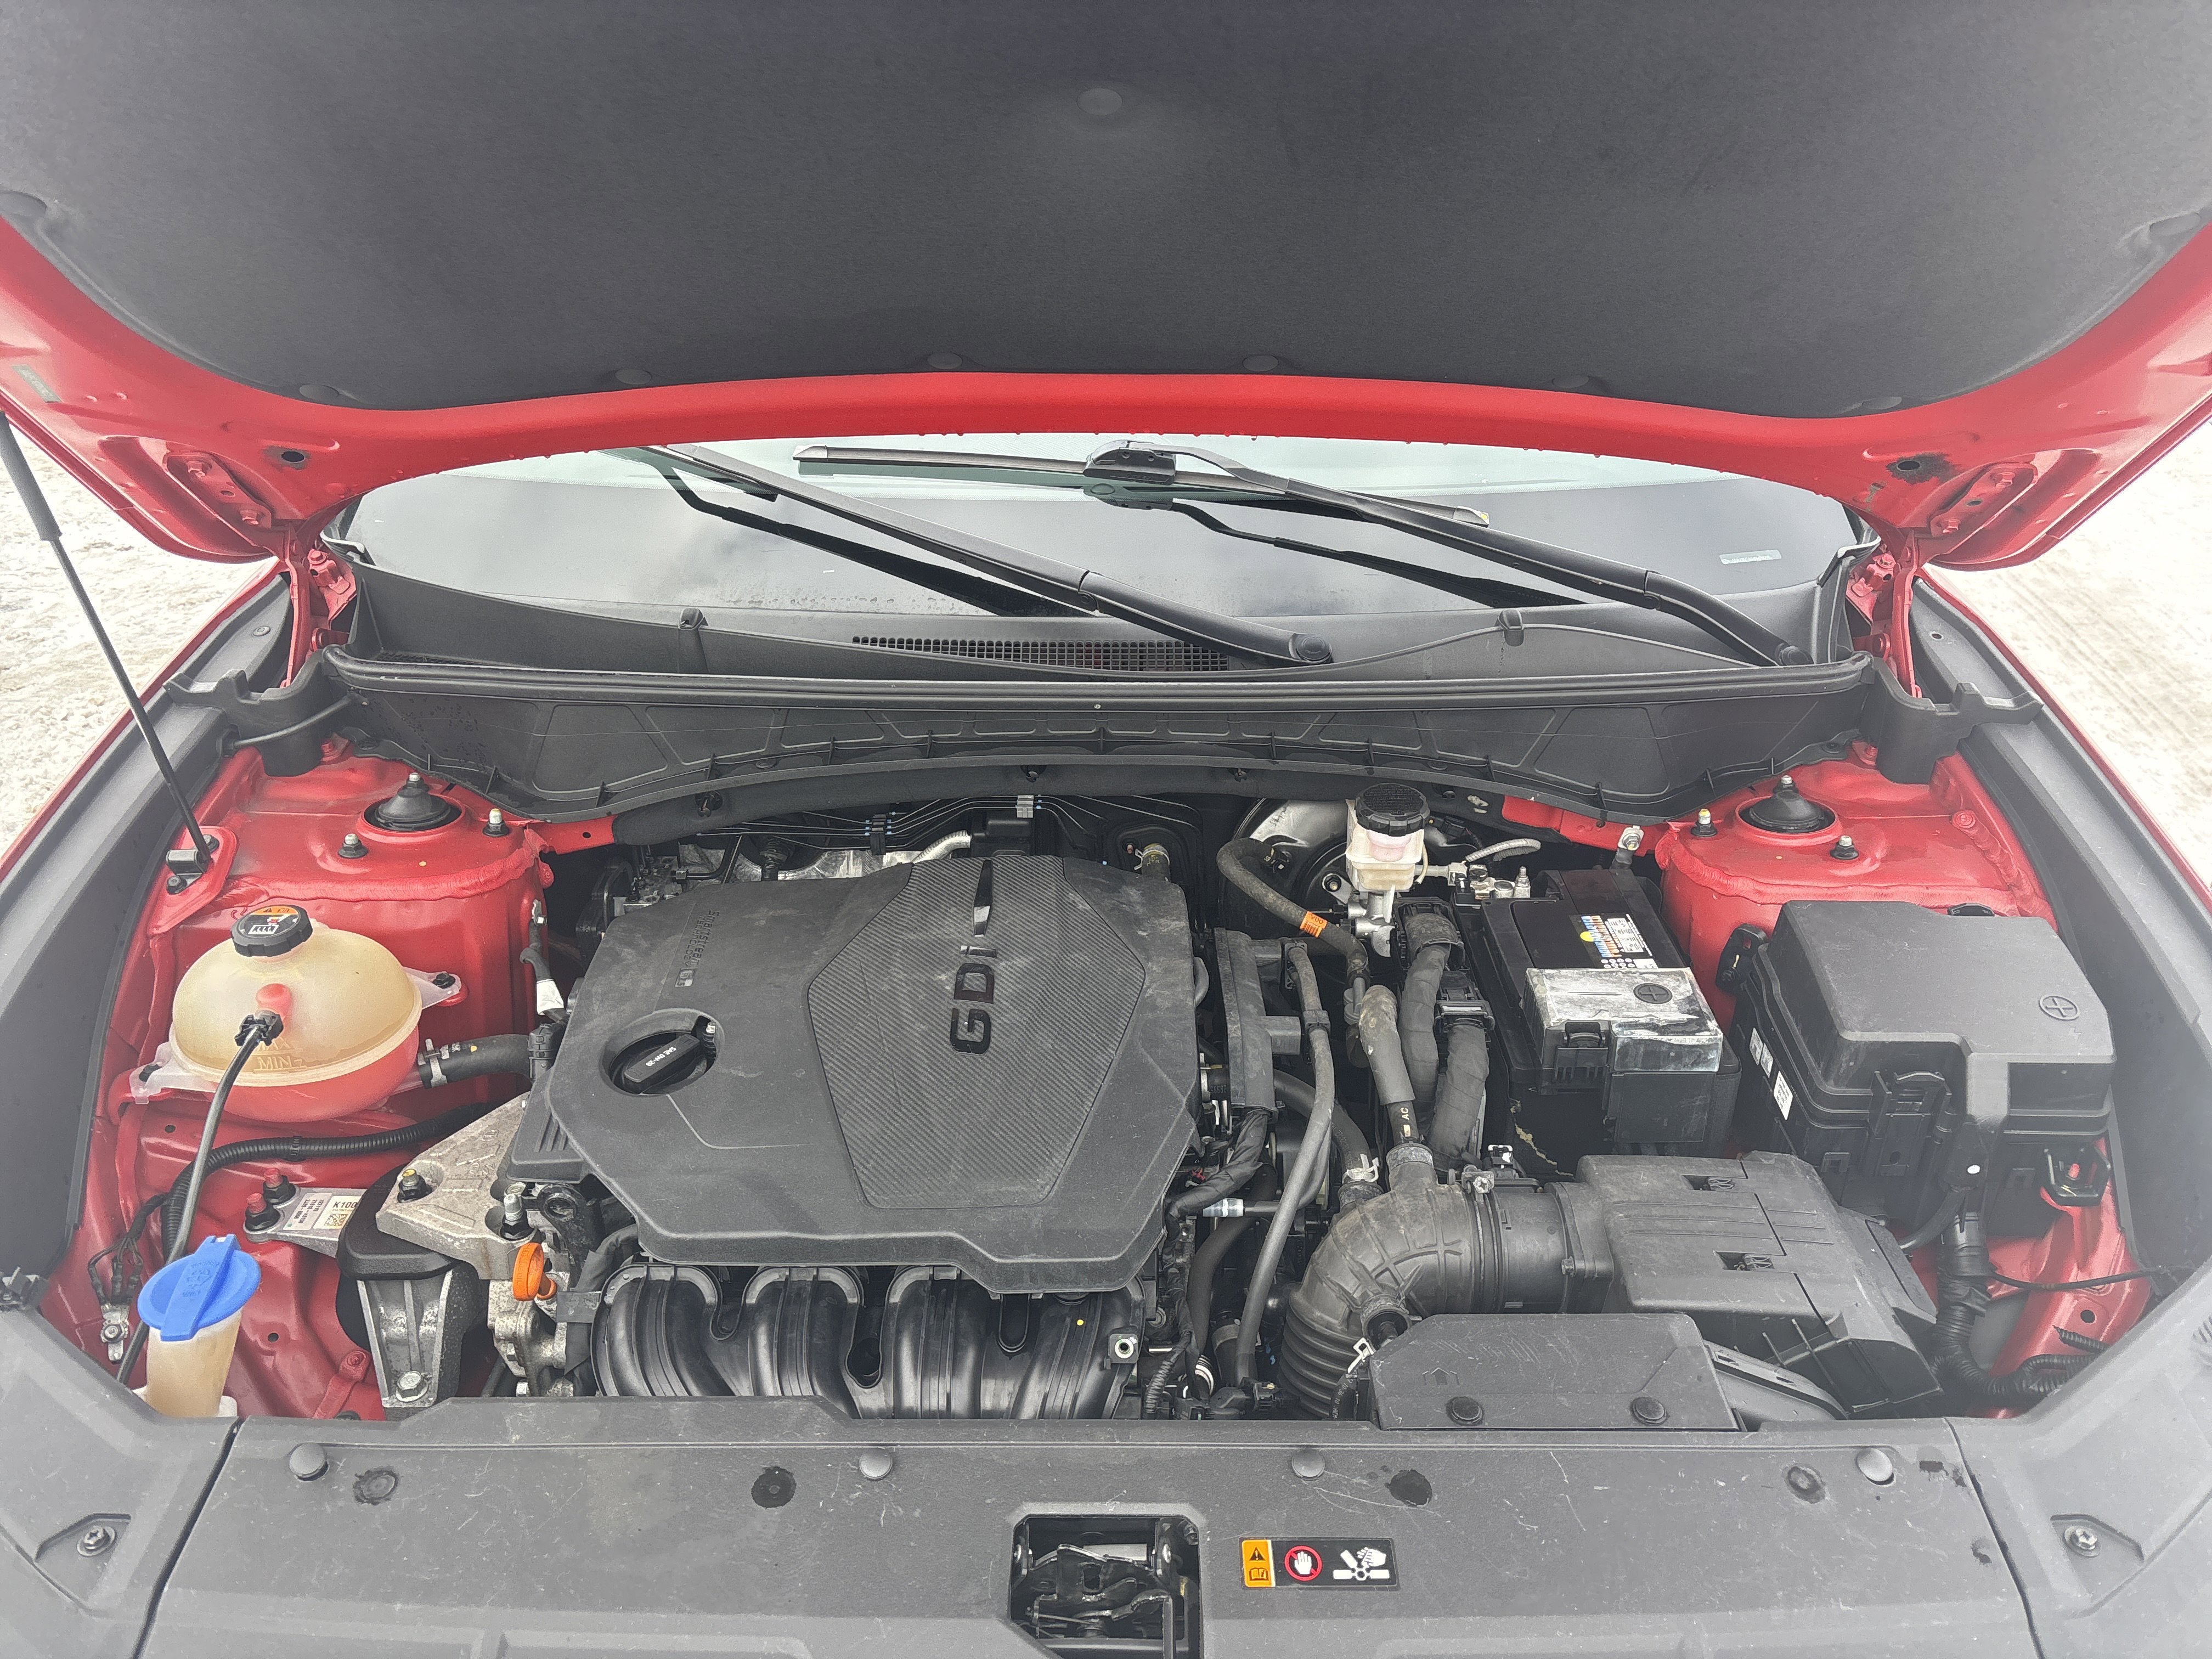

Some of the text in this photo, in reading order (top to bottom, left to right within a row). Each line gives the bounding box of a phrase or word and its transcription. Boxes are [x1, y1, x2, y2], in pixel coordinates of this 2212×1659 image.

[682, 916, 706, 966] TECHNOLOGY
[690, 910, 720, 966] Smartstream
[257, 1056, 292, 1069] MIN
[1400, 1107, 1409, 1120] AC
